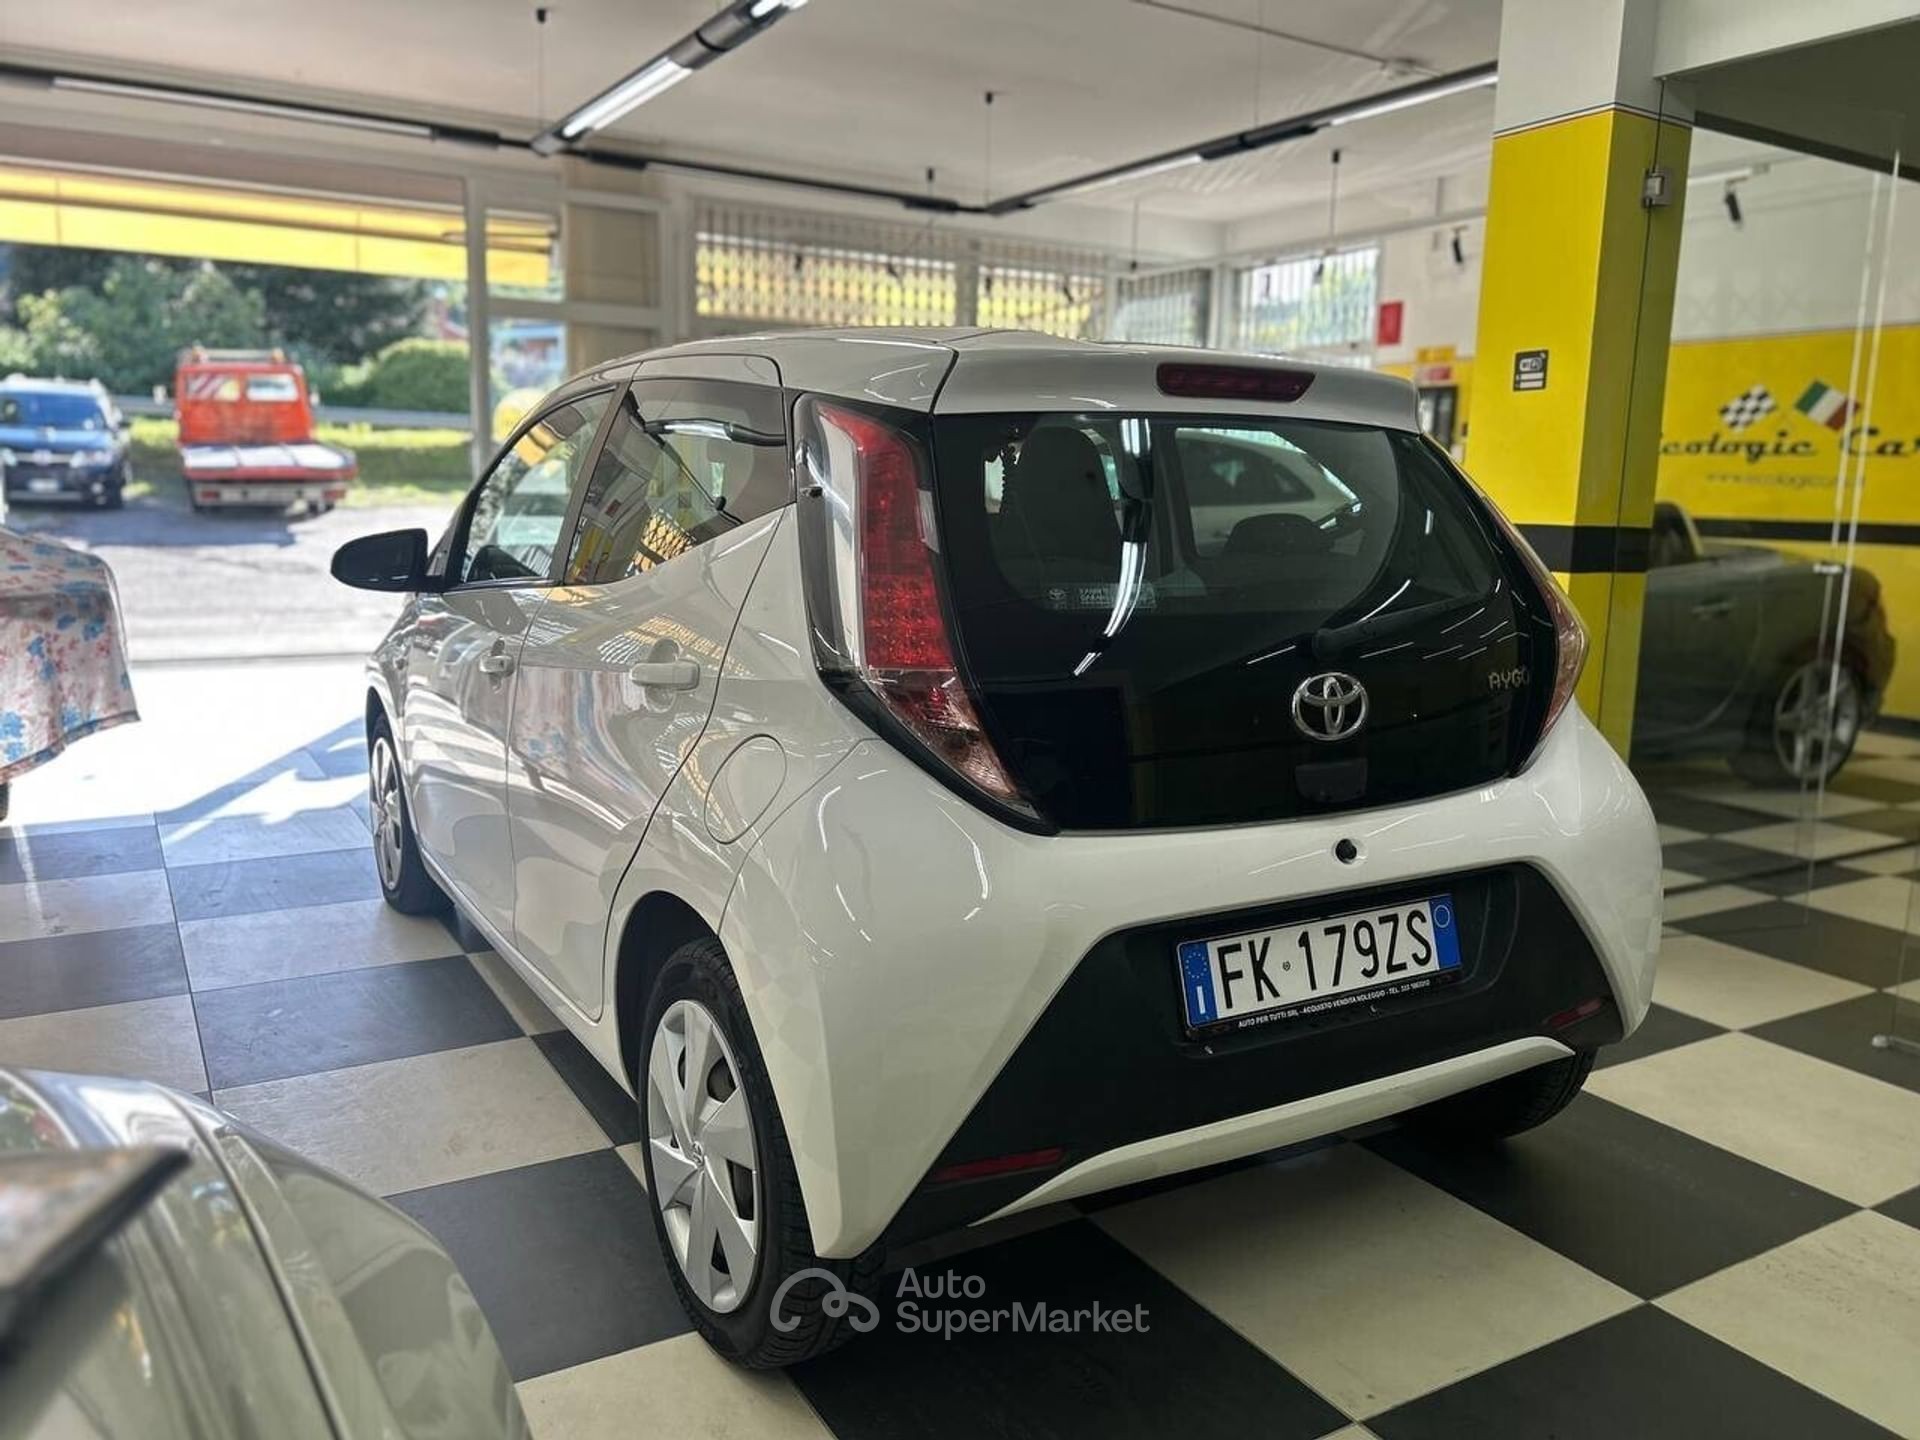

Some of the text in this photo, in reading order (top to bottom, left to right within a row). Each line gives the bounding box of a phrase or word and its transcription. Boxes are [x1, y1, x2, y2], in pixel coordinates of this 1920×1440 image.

[1659, 431, 1816, 464] cologic
[1488, 664, 1530, 689] AYGO
[1217, 936, 1280, 1009] FK
[1298, 910, 1432, 991] 179ZS
[1238, 1017, 1256, 1028] AUTO
[1256, 1014, 1269, 1024] PER
